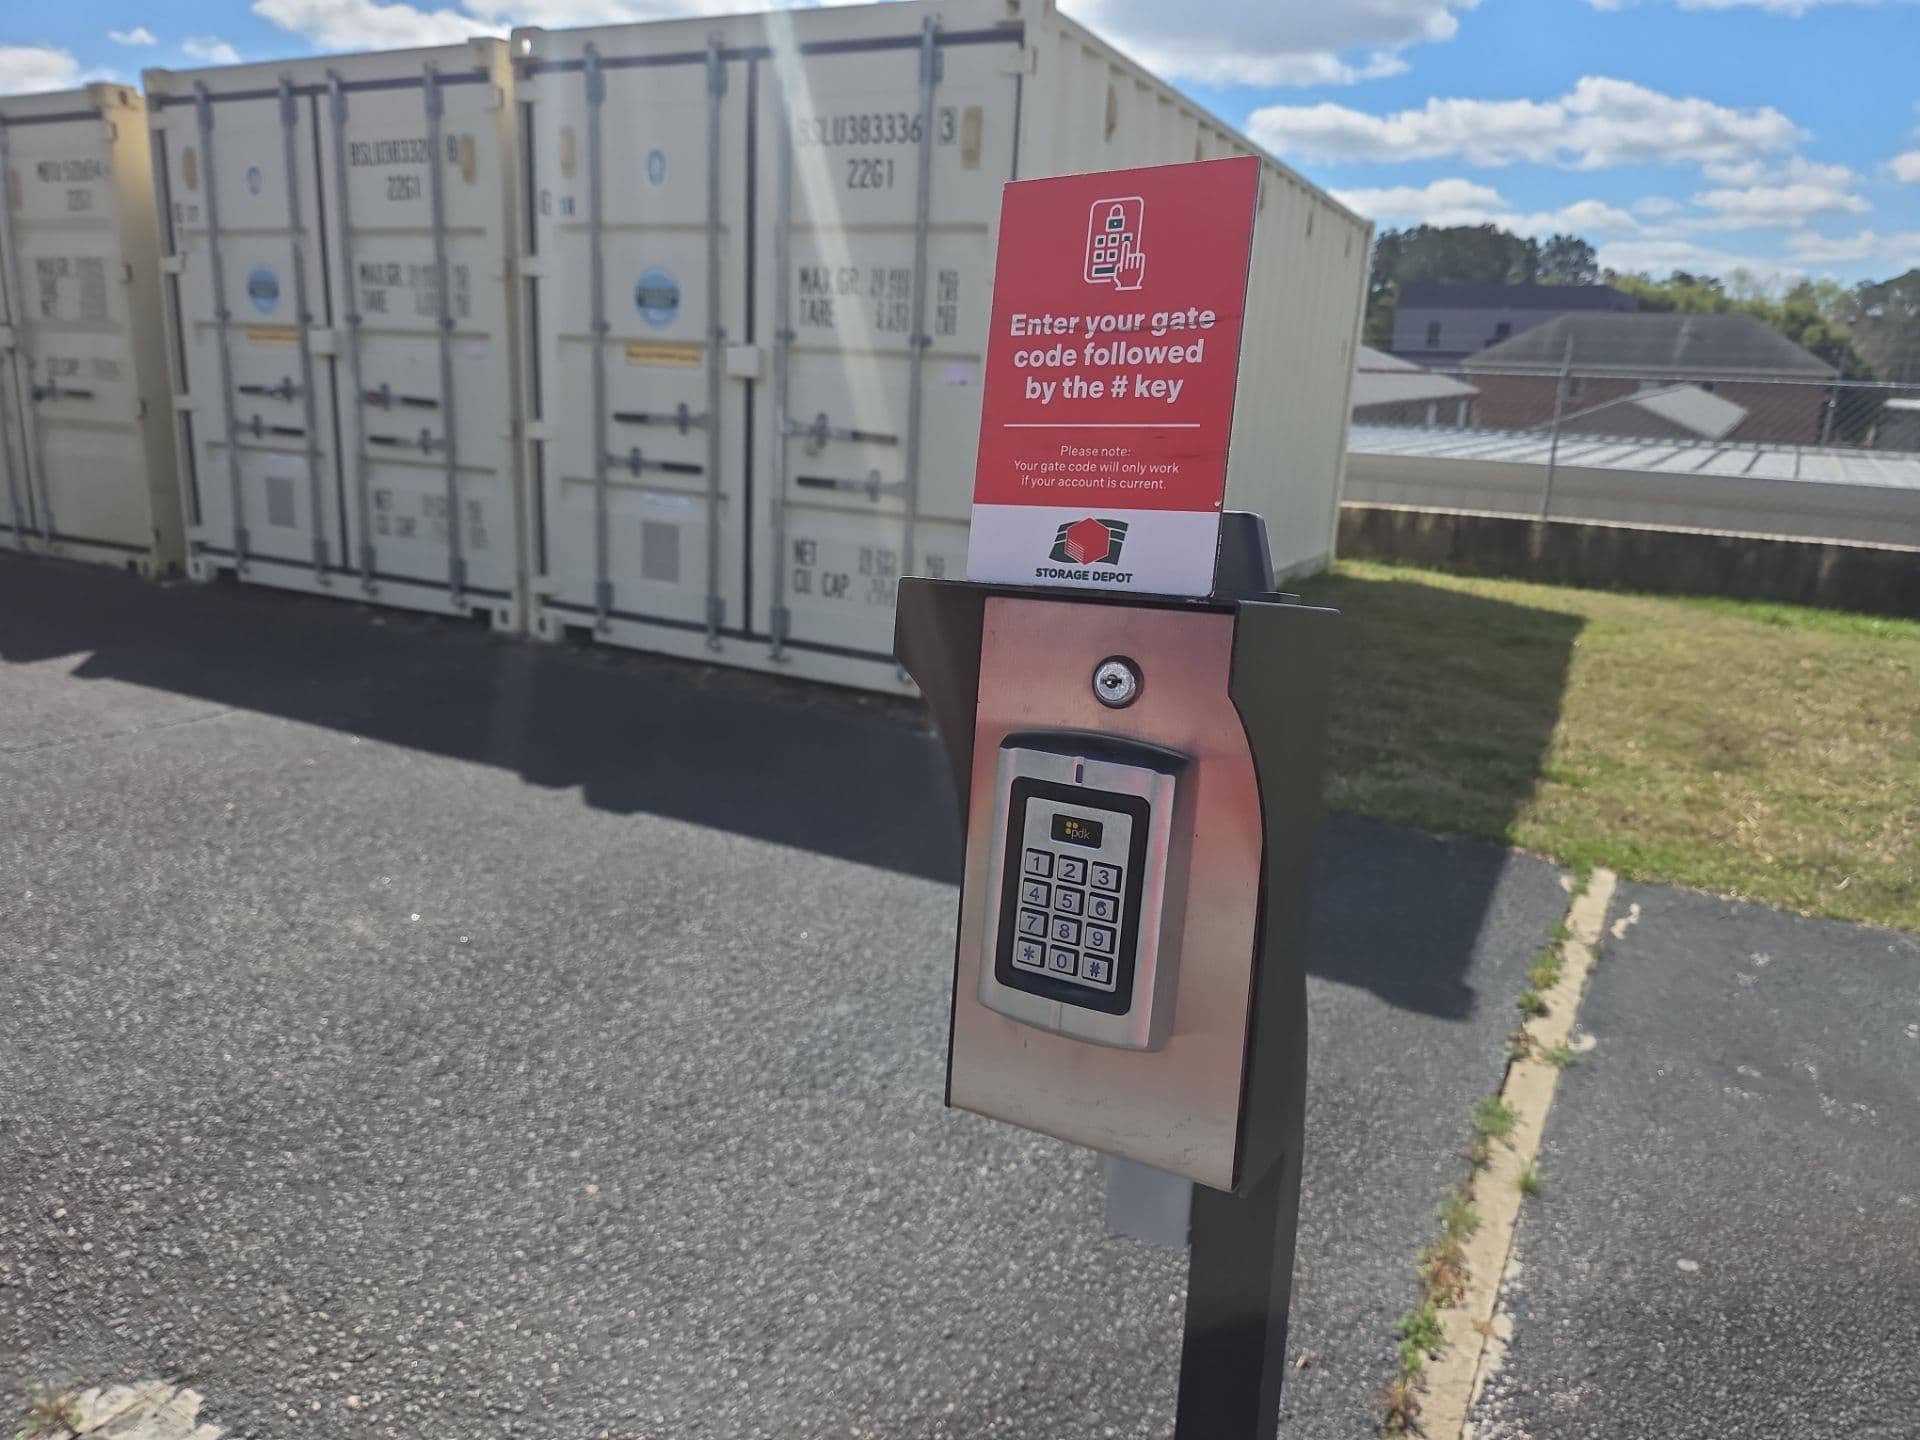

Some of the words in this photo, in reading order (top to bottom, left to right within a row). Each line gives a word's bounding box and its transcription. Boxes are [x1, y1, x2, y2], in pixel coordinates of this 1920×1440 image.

[941, 107, 956, 143] 3
[1010, 313, 1079, 337] Enter
[1084, 313, 1146, 339] your
[1151, 306, 1216, 337] gate
[1014, 343, 1077, 368] code
[1084, 338, 1205, 367] followed
[1025, 376, 1057, 405] by
[1062, 375, 1104, 399] the
[1111, 375, 1129, 398] #
[1134, 374, 1184, 404] key
[1060, 445, 1099, 457] Please
[1101, 446, 1131, 457] note:
[1014, 460, 1038, 471] Your
[1040, 461, 1065, 473] gate
[1068, 460, 1097, 472] code
[1099, 461, 1119, 473] will
[1121, 462, 1147, 475] only
[1149, 463, 1179, 474] work
[1021, 475, 1029, 486] if
[1031, 478, 1055, 488] your
[1058, 477, 1104, 488] account
[1107, 477, 1117, 488] is
[1119, 479, 1166, 490] current.
[1035, 567, 1090, 581] STORAGE
[1092, 570, 1133, 584] DEPOT
[1071, 827, 1090, 840] pdk
[1033, 855, 1040, 871] 1
[1063, 863, 1076, 879] 2
[1098, 869, 1110, 886] 3
[1029, 887, 1040, 902] 4
[1062, 893, 1073, 909] 5
[1095, 900, 1107, 917] 6
[1027, 915, 1038, 931] 7
[1059, 923, 1070, 939] 8
[1092, 931, 1104, 947] 9
[1056, 953, 1067, 969] 0
[1089, 961, 1101, 978] #
